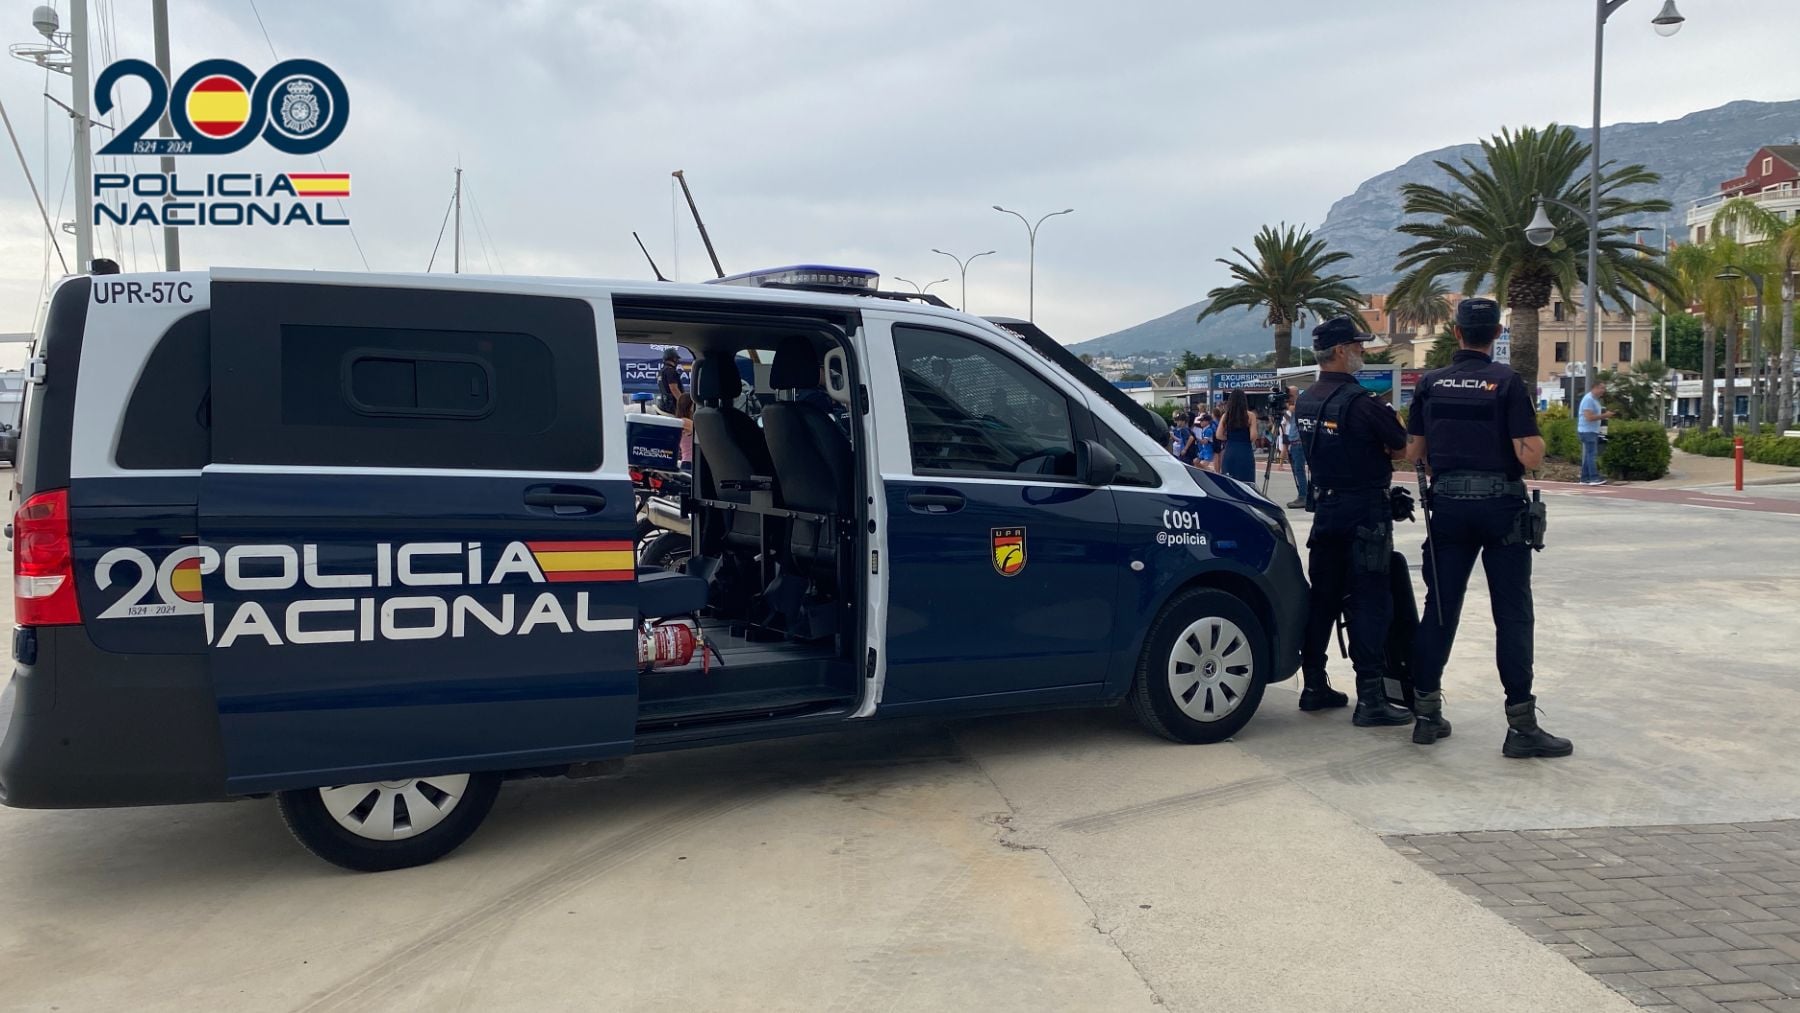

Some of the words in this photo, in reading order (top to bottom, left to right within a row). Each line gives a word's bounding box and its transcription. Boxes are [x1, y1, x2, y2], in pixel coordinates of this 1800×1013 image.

[94, 281, 194, 305] UPR-57C
[1496, 346, 1507, 356] 24
[1156, 531, 1207, 547] @policia
[204, 591, 634, 648] ACIONAL
